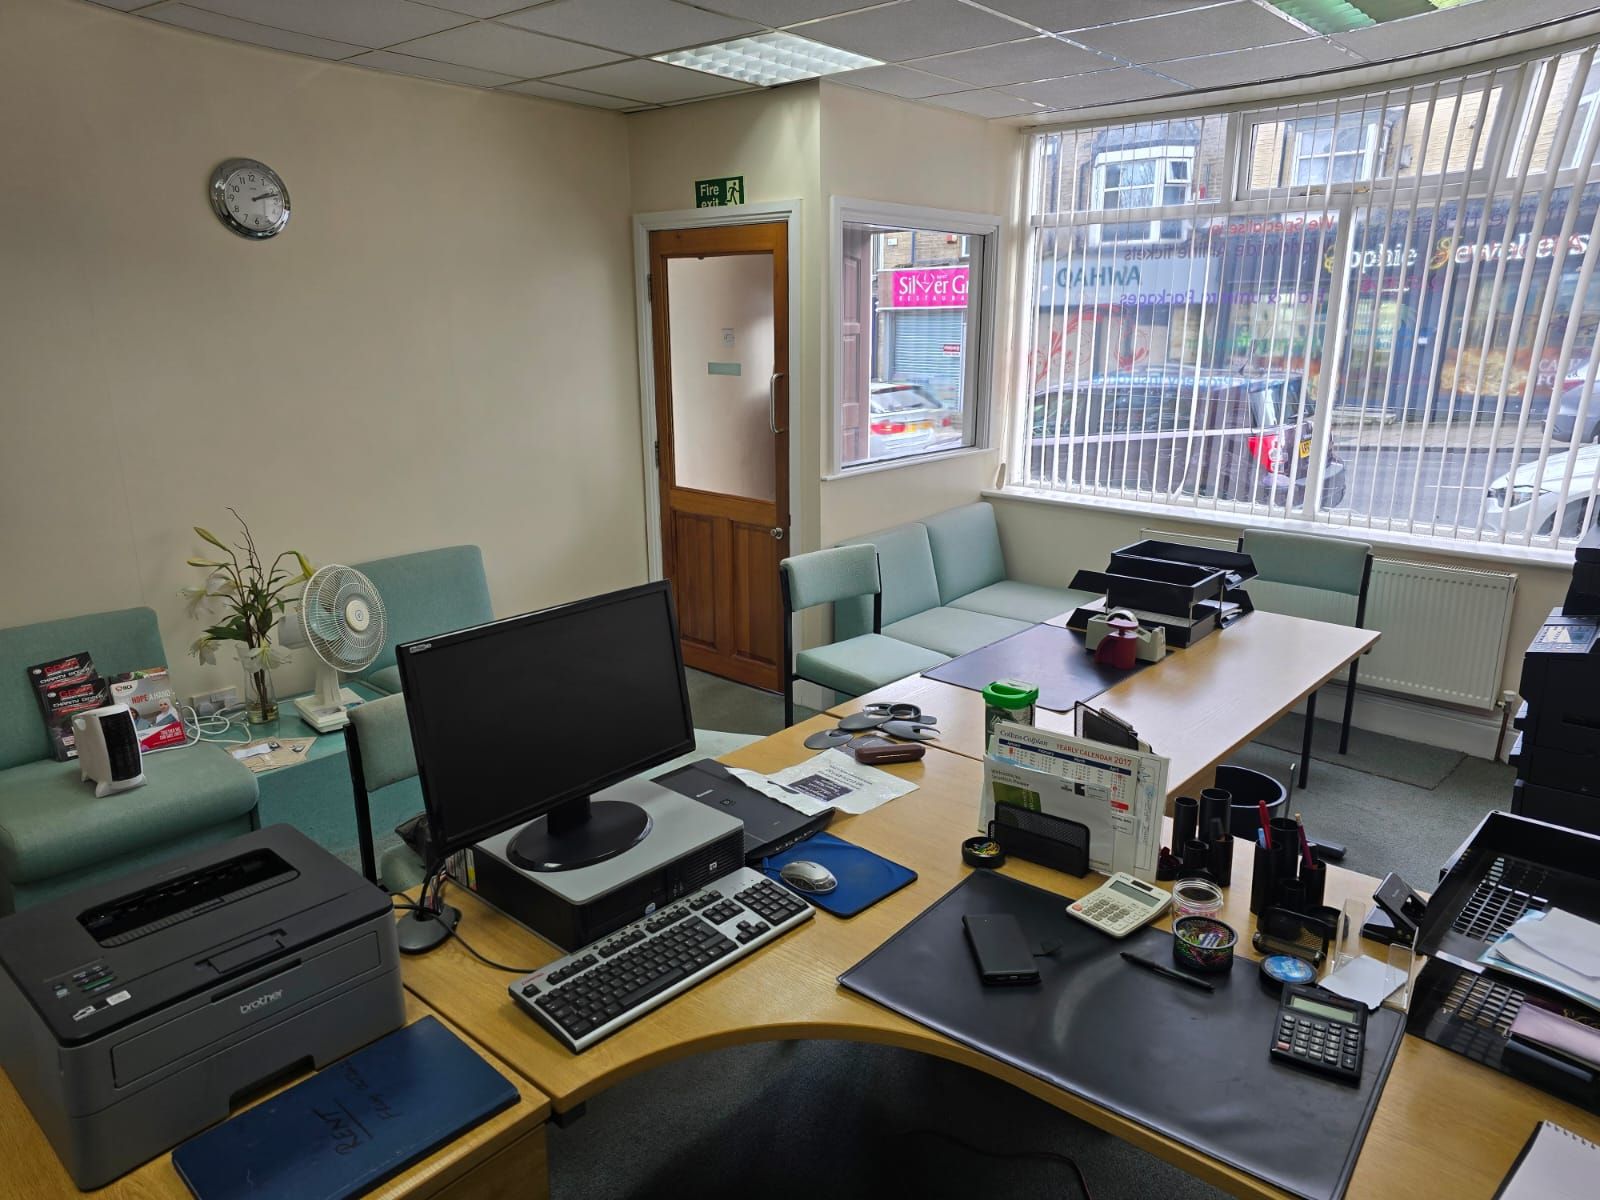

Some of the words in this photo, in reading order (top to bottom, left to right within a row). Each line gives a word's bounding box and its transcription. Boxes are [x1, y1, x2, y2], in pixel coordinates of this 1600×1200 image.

[700, 184, 720, 197] Fire
[700, 197, 719, 208] exit
[899, 273, 949, 295] Silver
[1056, 743, 1079, 755] YEARLY
[1079, 749, 1113, 762] CALENDAR
[1113, 755, 1132, 767] 2017
[240, 989, 283, 1014] brother
